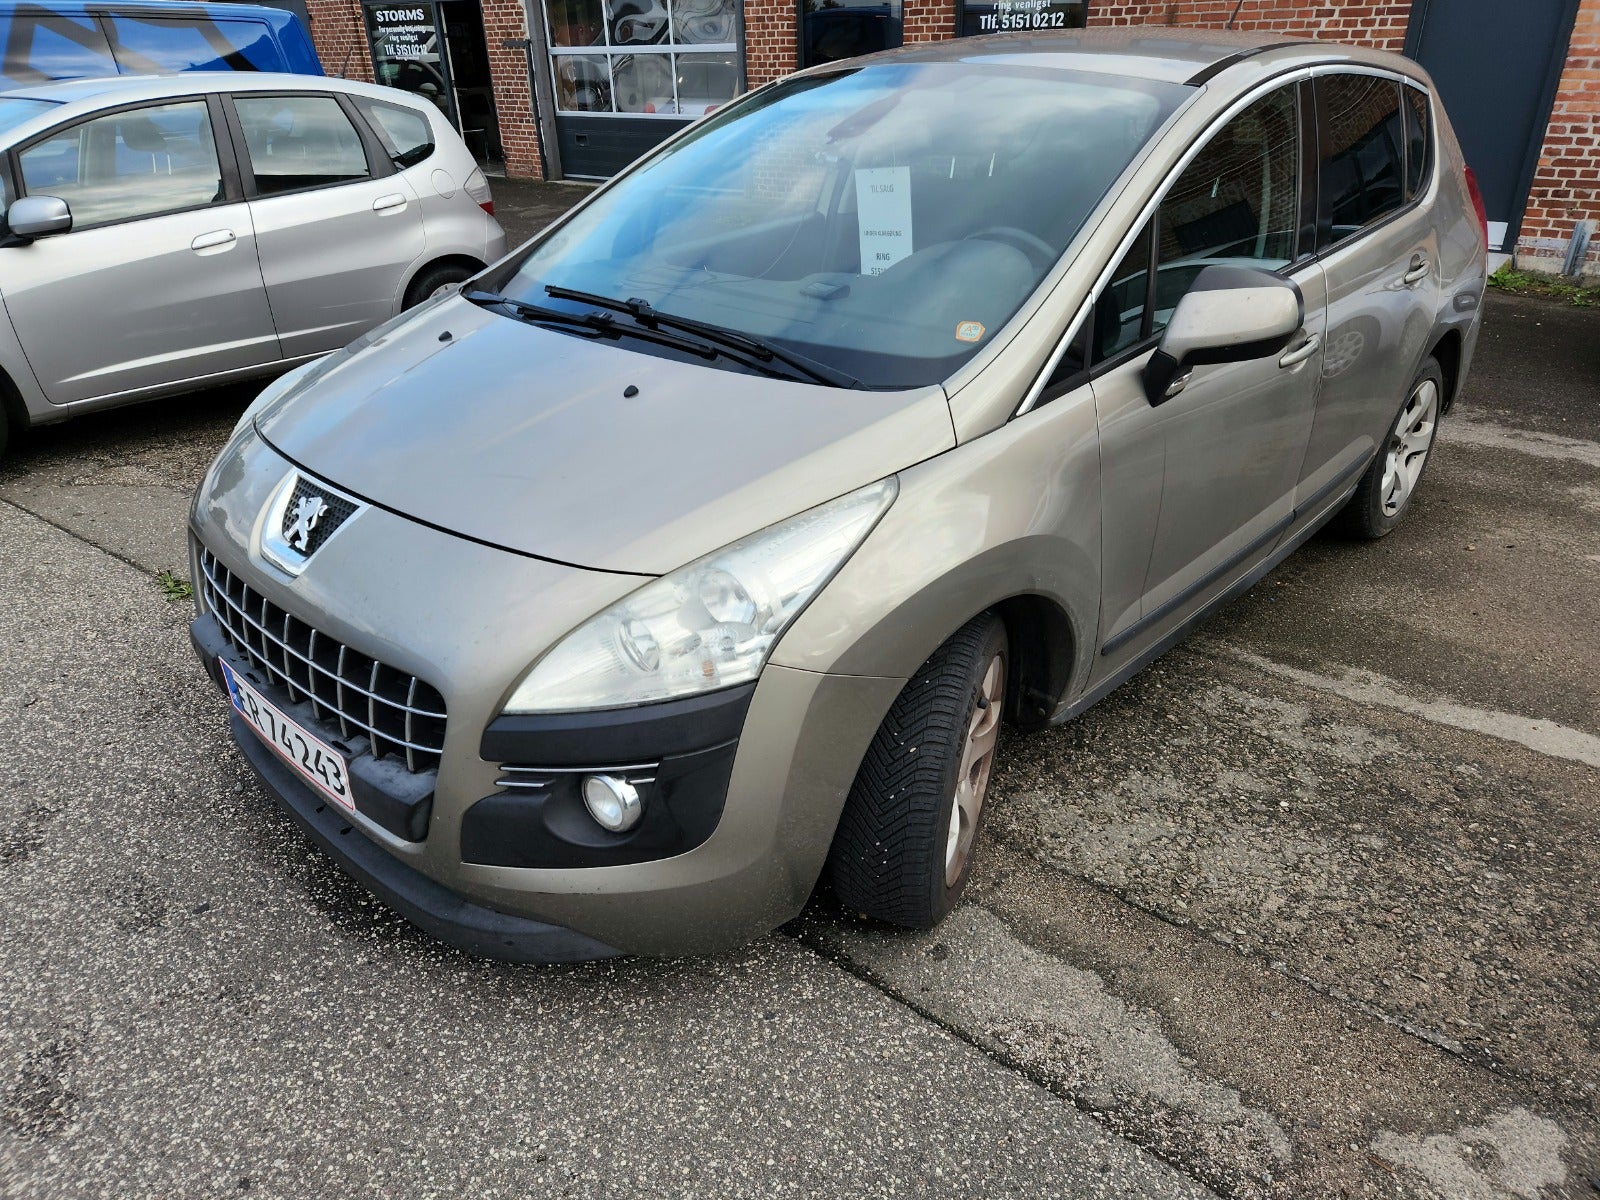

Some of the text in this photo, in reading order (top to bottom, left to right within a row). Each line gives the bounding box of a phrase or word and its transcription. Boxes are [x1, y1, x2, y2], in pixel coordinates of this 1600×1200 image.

[993, 0, 1051, 11] ring venligst
[376, 8, 425, 22] STORMS
[980, 14, 999, 29] Tlf.
[389, 34, 418, 43] ring venligst
[384, 44, 396, 56] Tlf.
[871, 183, 894, 193] TIL SALG
[876, 252, 890, 261] RING
